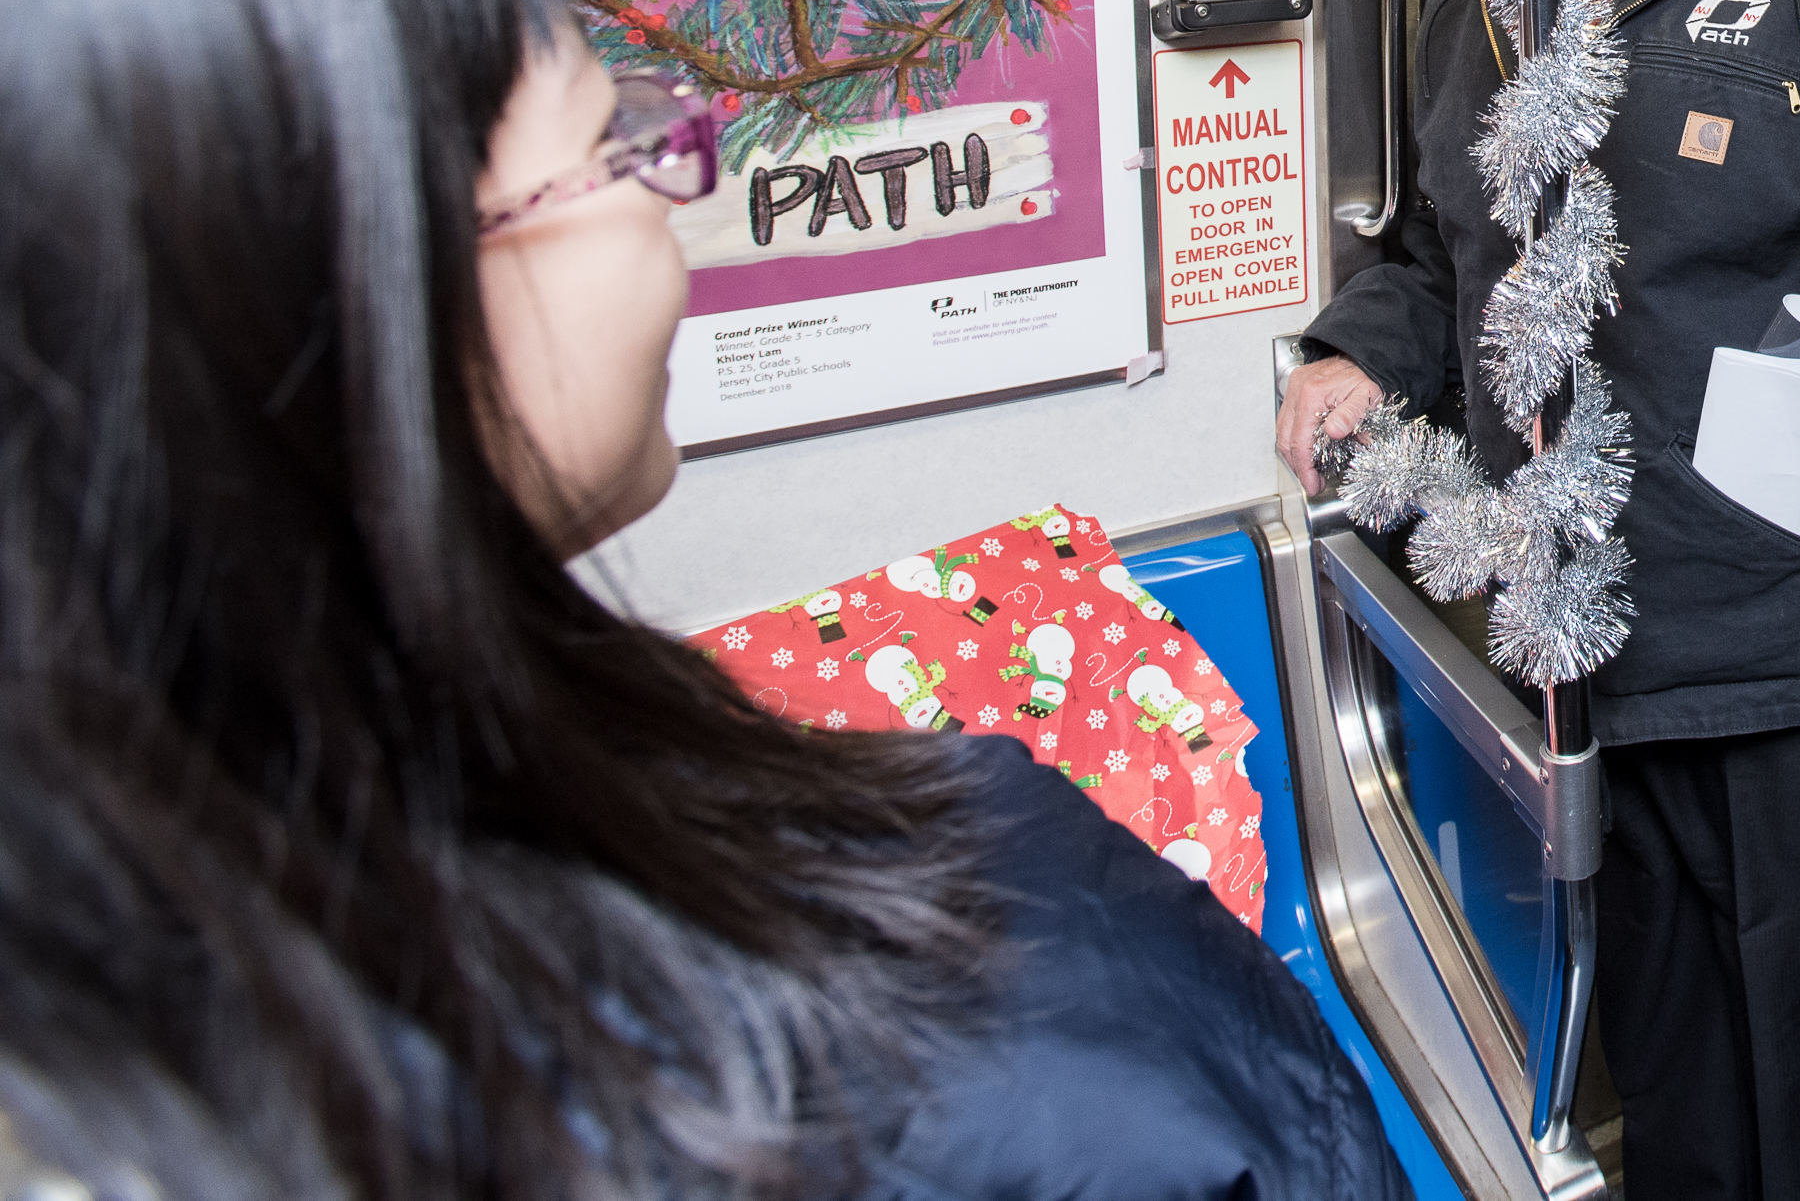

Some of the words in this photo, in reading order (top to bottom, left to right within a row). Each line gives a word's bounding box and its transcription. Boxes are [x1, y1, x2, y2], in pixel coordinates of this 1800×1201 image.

[1743, 13, 1760, 22] NY
[1172, 108, 1288, 148] MANUAL
[1166, 152, 1298, 195] CONTROL
[749, 132, 992, 246] PATH
[1189, 203, 1215, 219] TO
[1220, 195, 1273, 215] OPEN
[1190, 220, 1246, 241] DOOR
[1256, 217, 1274, 232] IN
[1175, 234, 1294, 265] EMERGENCY
[1170, 267, 1223, 287] OPEN
[1234, 255, 1298, 278] COVER
[992, 290, 1009, 300] THE
[1010, 287, 1032, 297] PORT
[1033, 279, 1079, 293] AUTHORITY
[1171, 288, 1220, 309] PULL
[1226, 276, 1300, 300] HANDLE
[940, 306, 977, 319] PATH
[714, 326, 751, 341] Grand
[754, 324, 783, 335] Prize
[787, 316, 829, 330] Winner
[830, 315, 838, 323] &
[715, 339, 756, 353] Winner,
[759, 333, 792, 346] Grade
[795, 332, 802, 341] 3
[815, 329, 822, 338] 5
[825, 322, 872, 336] Category
[963, 323, 991, 334] website
[716, 352, 756, 365] Khloey
[758, 348, 782, 358] Lam
[718, 366, 736, 377] P.S.
[739, 364, 756, 374] 25,
[759, 357, 791, 370] Grade
[794, 356, 801, 365] 5
[718, 377, 751, 389] Jersey
[754, 372, 774, 383] City
[777, 366, 809, 379] Public
[811, 359, 852, 374] Schools
[720, 387, 766, 402] December
[769, 383, 792, 394] 2018
